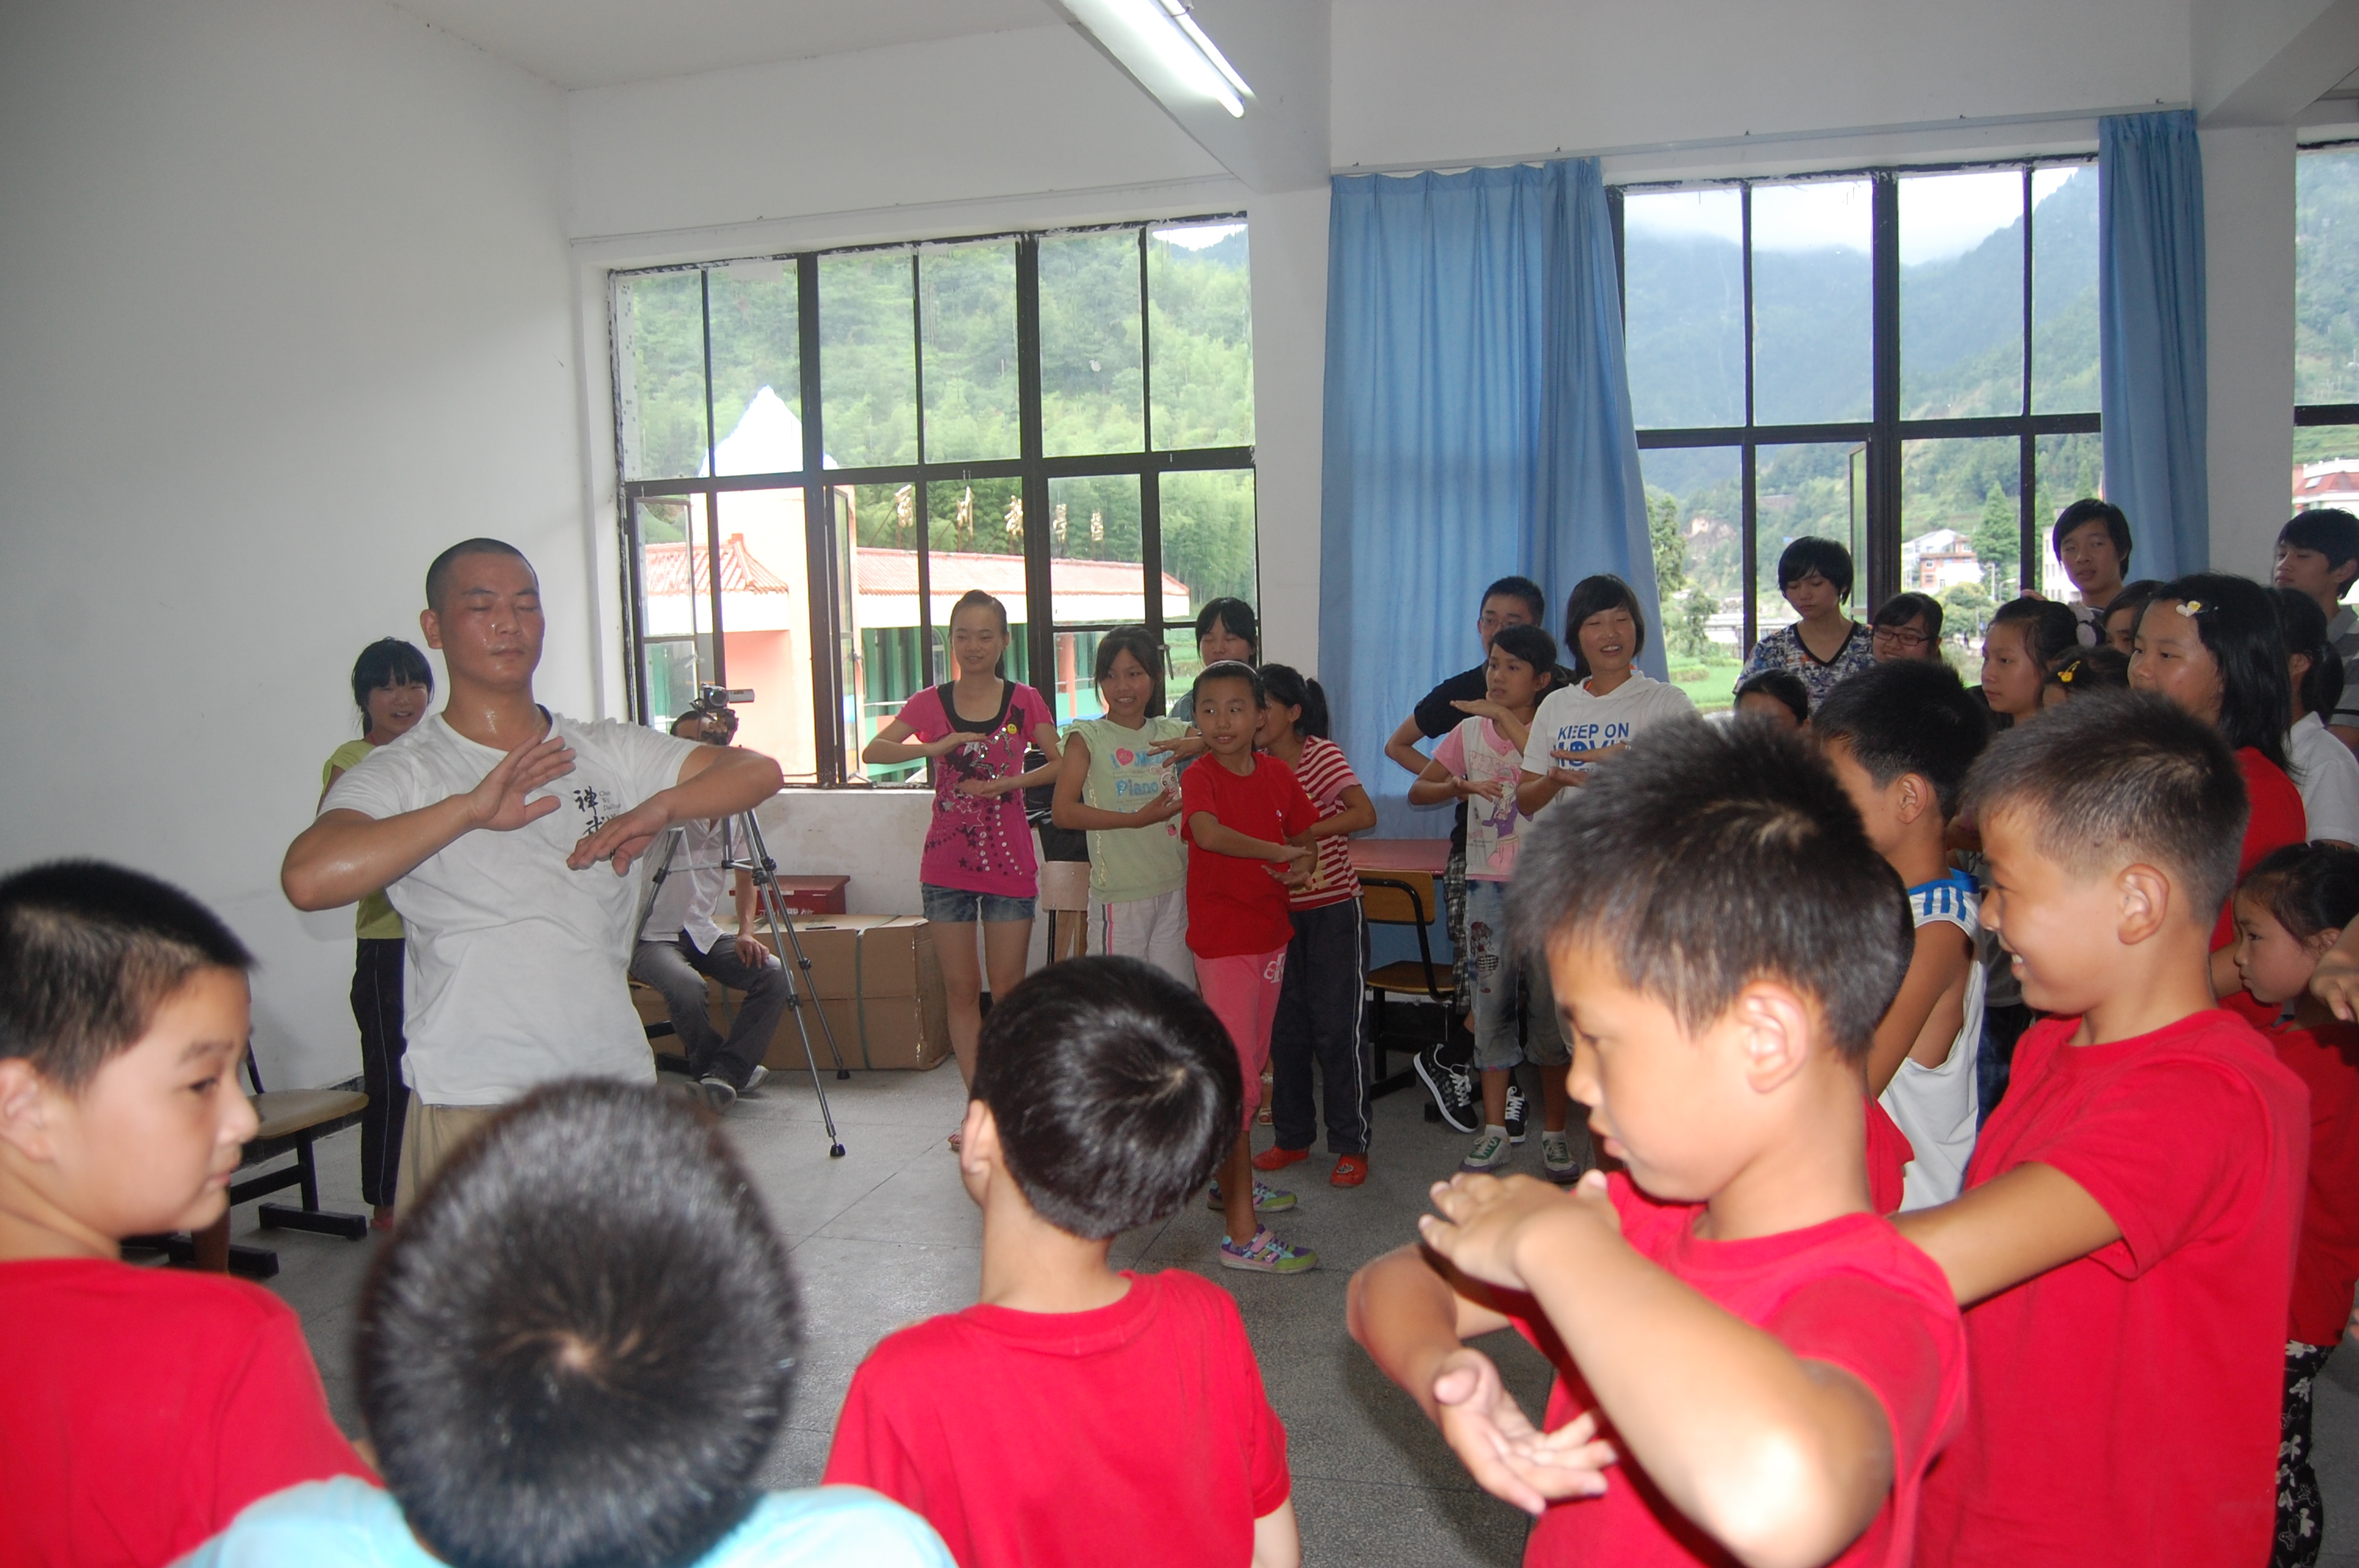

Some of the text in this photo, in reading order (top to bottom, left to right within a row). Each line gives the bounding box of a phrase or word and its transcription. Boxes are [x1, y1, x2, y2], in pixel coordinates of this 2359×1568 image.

[1558, 722, 1630, 741] KEEP ON
[1115, 779, 1159, 798] Piano
